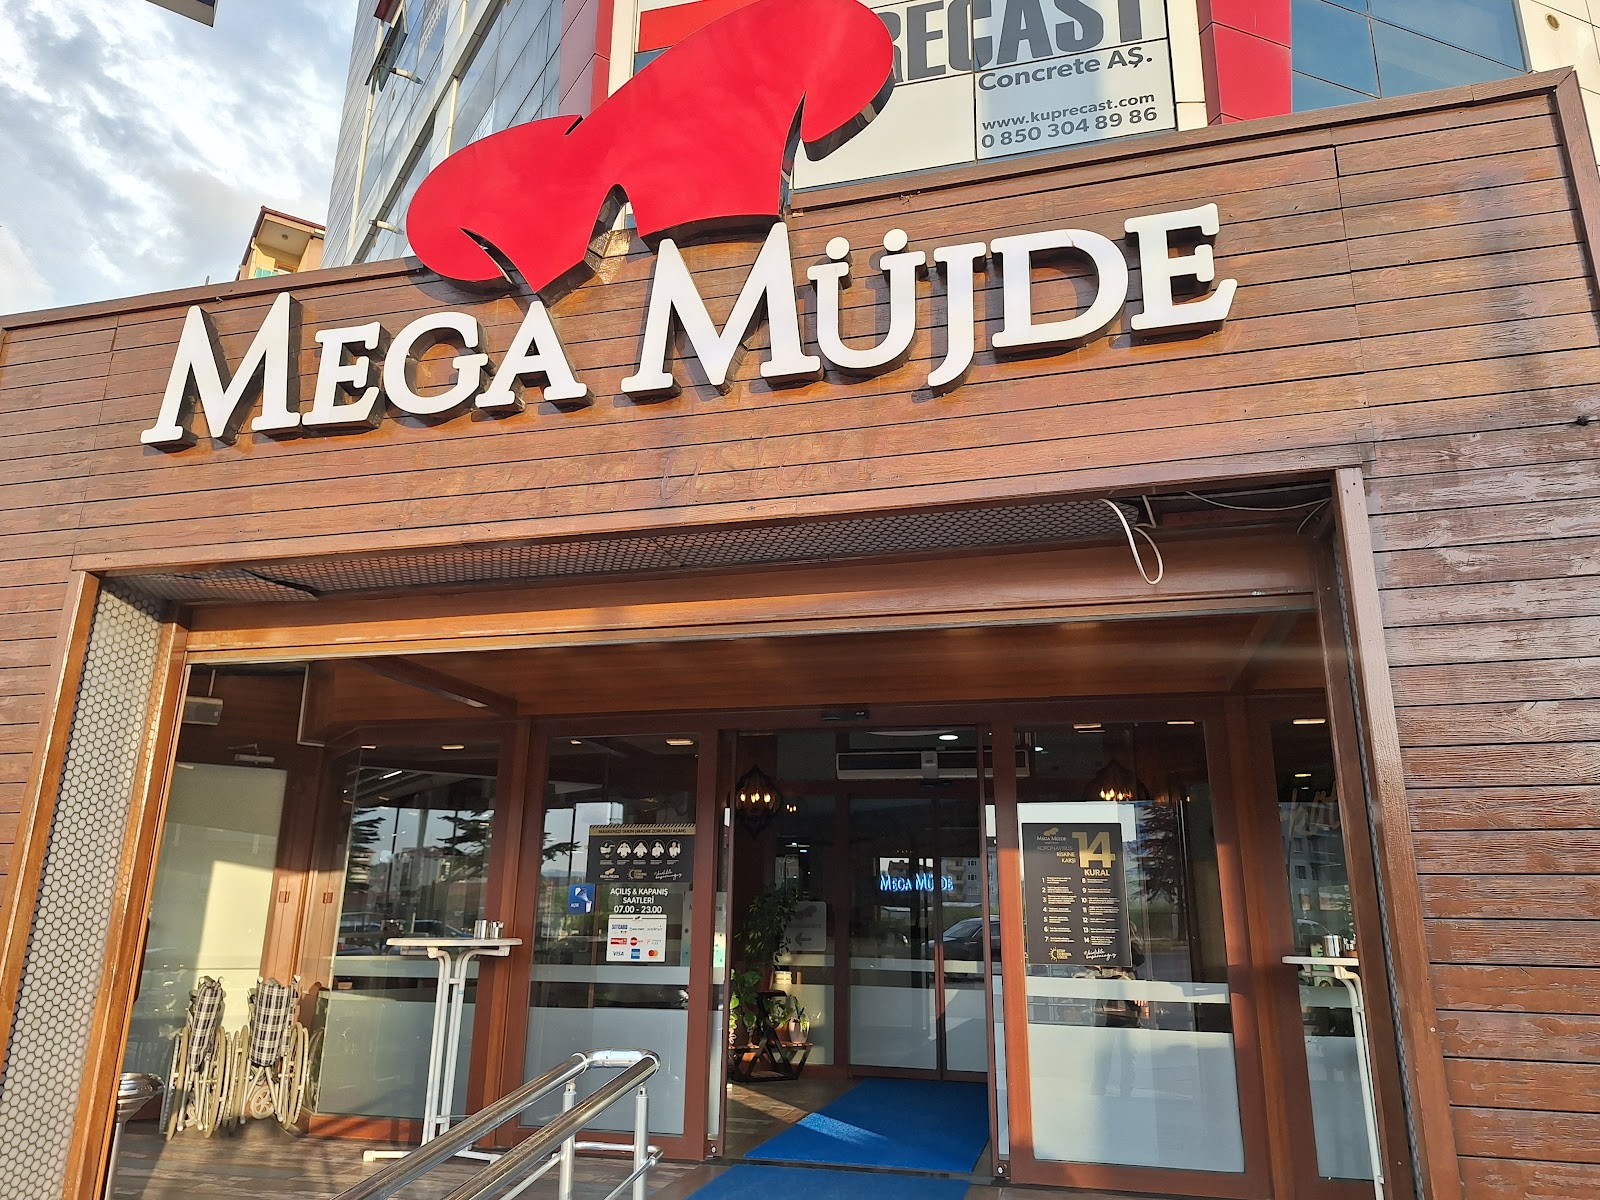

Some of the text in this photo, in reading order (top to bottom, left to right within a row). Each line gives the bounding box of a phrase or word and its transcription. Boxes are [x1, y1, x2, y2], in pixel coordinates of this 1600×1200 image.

[978, 46, 1153, 91] Concrete AŞ.
[981, 106, 1158, 149] 0 850 304 89 86
[982, 93, 1155, 131] www.kuprecast.com
[140, 202, 1238, 445] MEGA MÜJDE
[1071, 831, 1116, 868] 14
[610, 888, 631, 896] AÇILIŞ
[638, 888, 668, 897] KAPANIŞ
[622, 896, 654, 904] SAATLERİ
[915, 872, 954, 891] MÜDE
[613, 905, 635, 913] 07.00
[640, 905, 662, 913] 23.00
